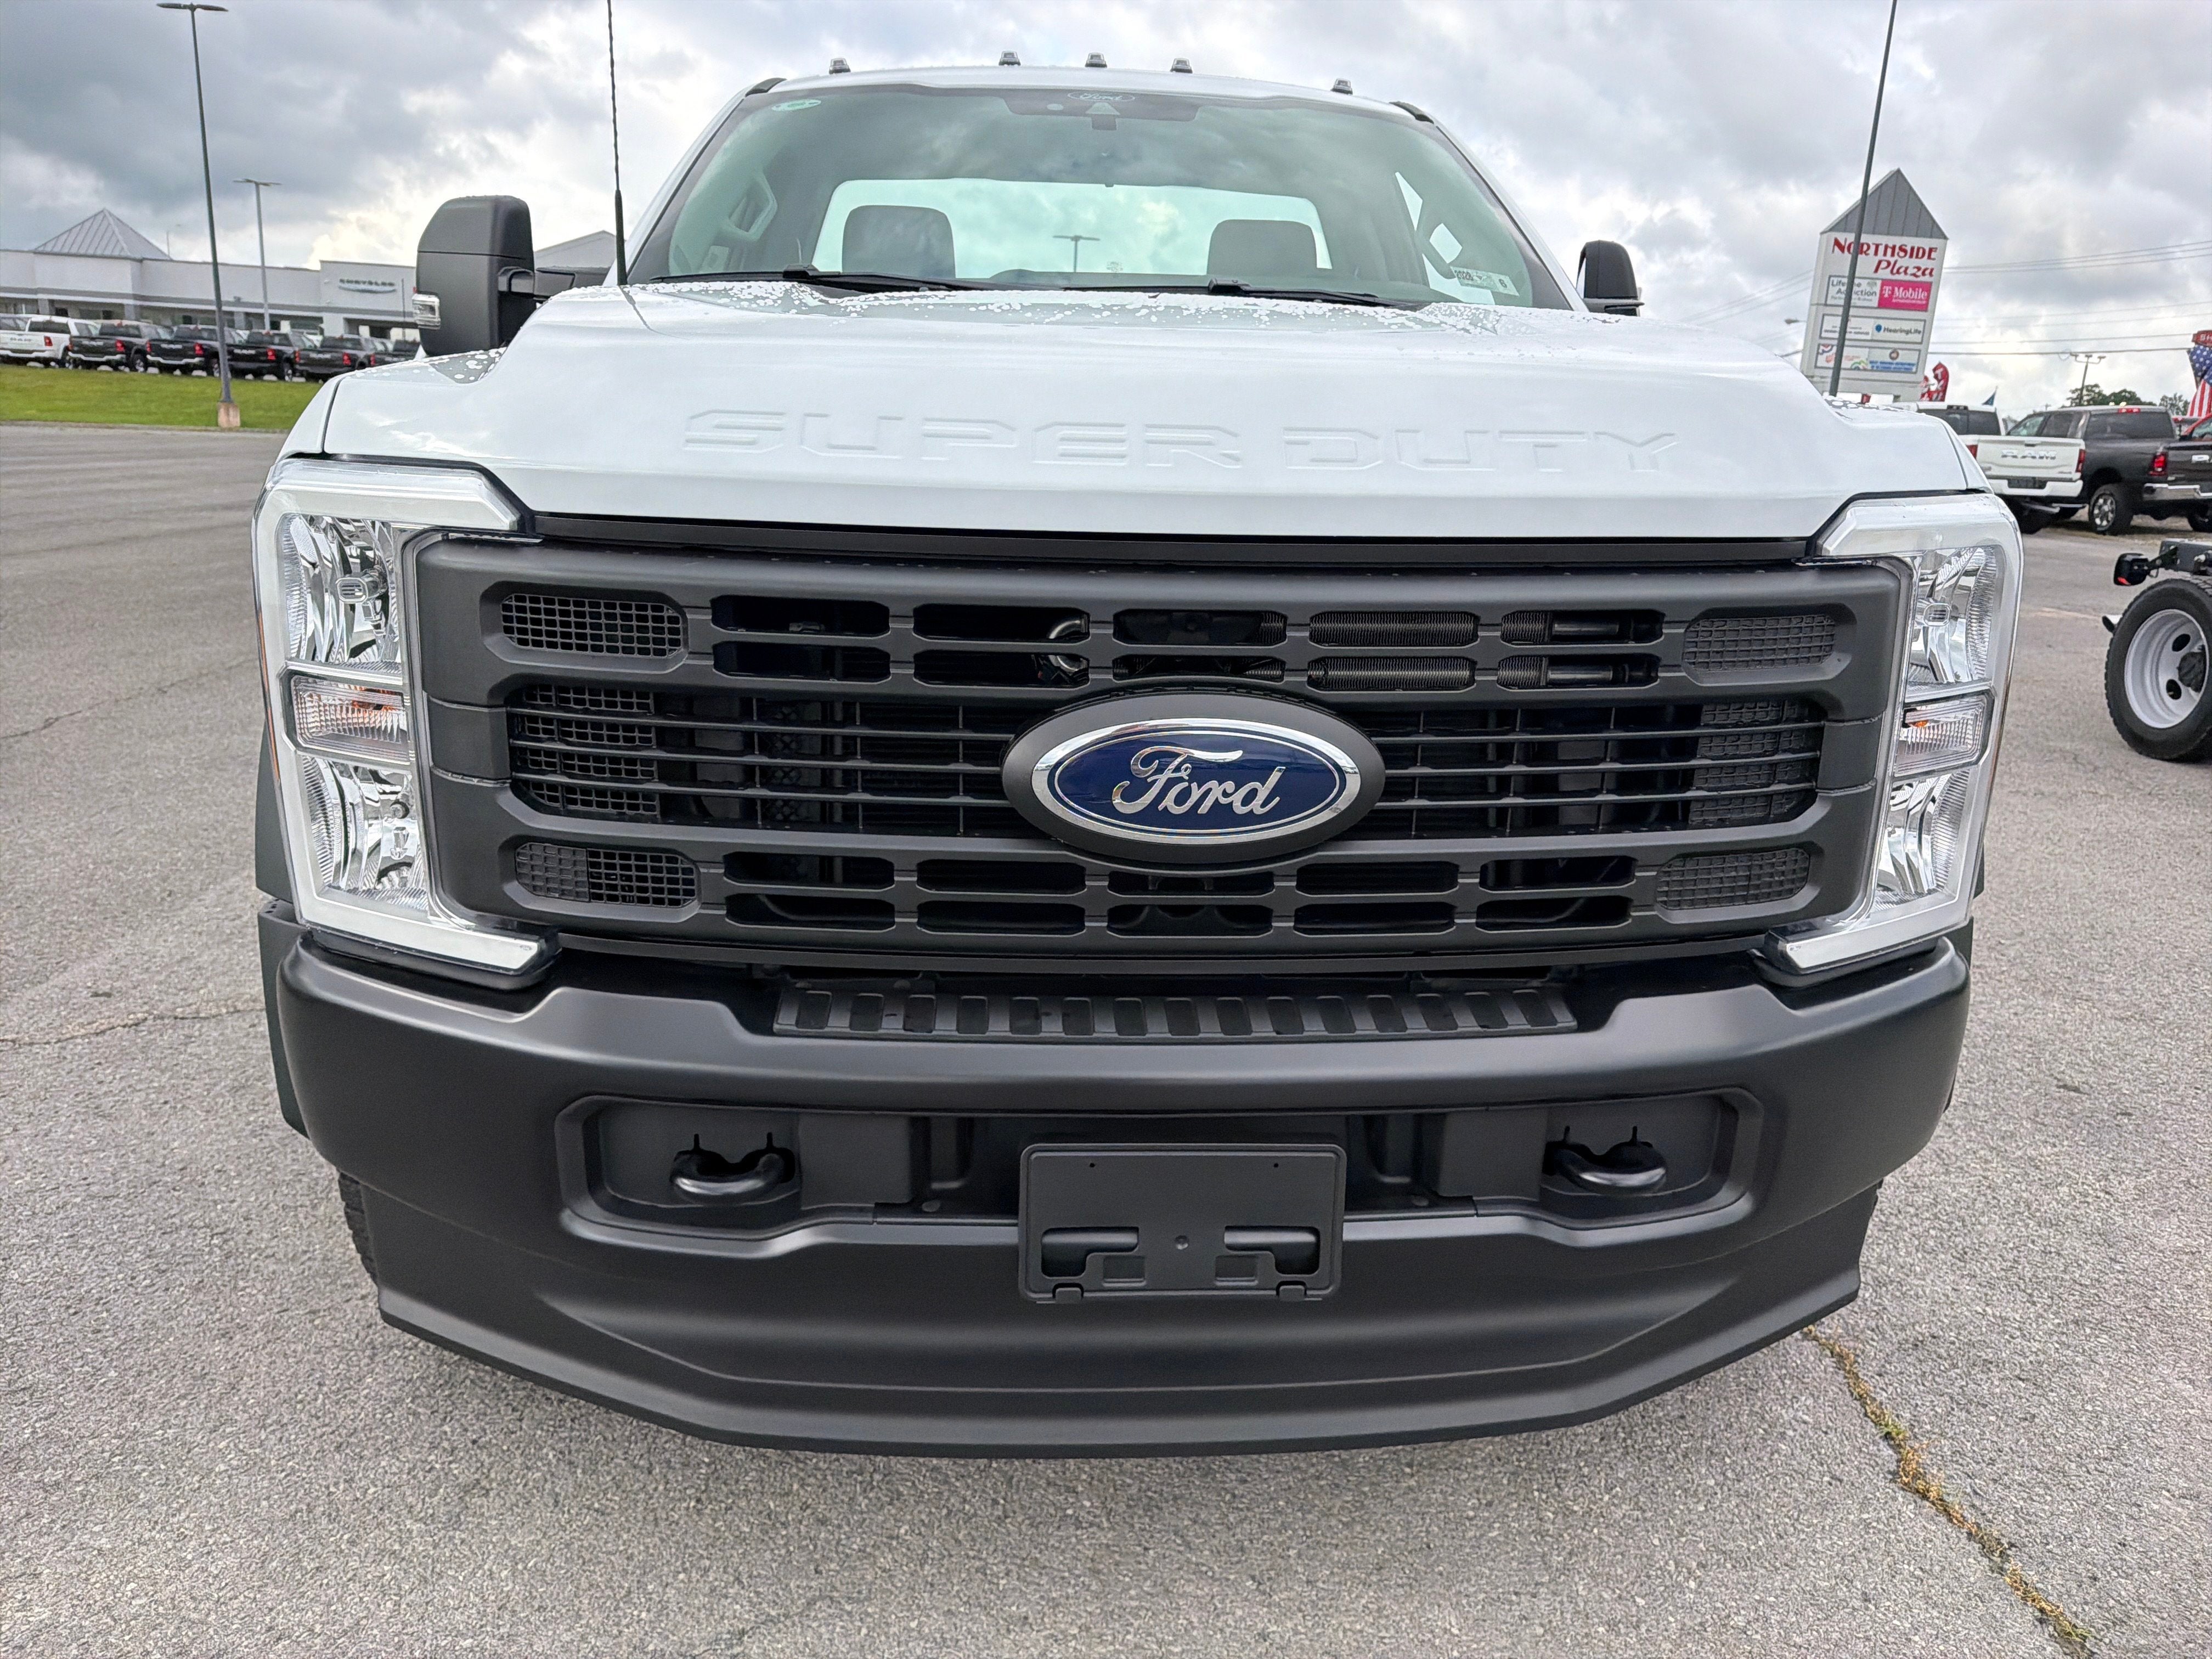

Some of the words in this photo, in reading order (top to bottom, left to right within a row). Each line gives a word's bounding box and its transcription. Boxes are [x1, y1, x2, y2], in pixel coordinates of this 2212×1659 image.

[1873, 259, 1935, 278] Plaza
[1836, 287, 1877, 297] Aiction
[1893, 286, 1927, 300] Mobile
[683, 409, 1243, 469] SUPER
[1282, 426, 1678, 472] DUTY
[1112, 745, 1286, 815] Ford
